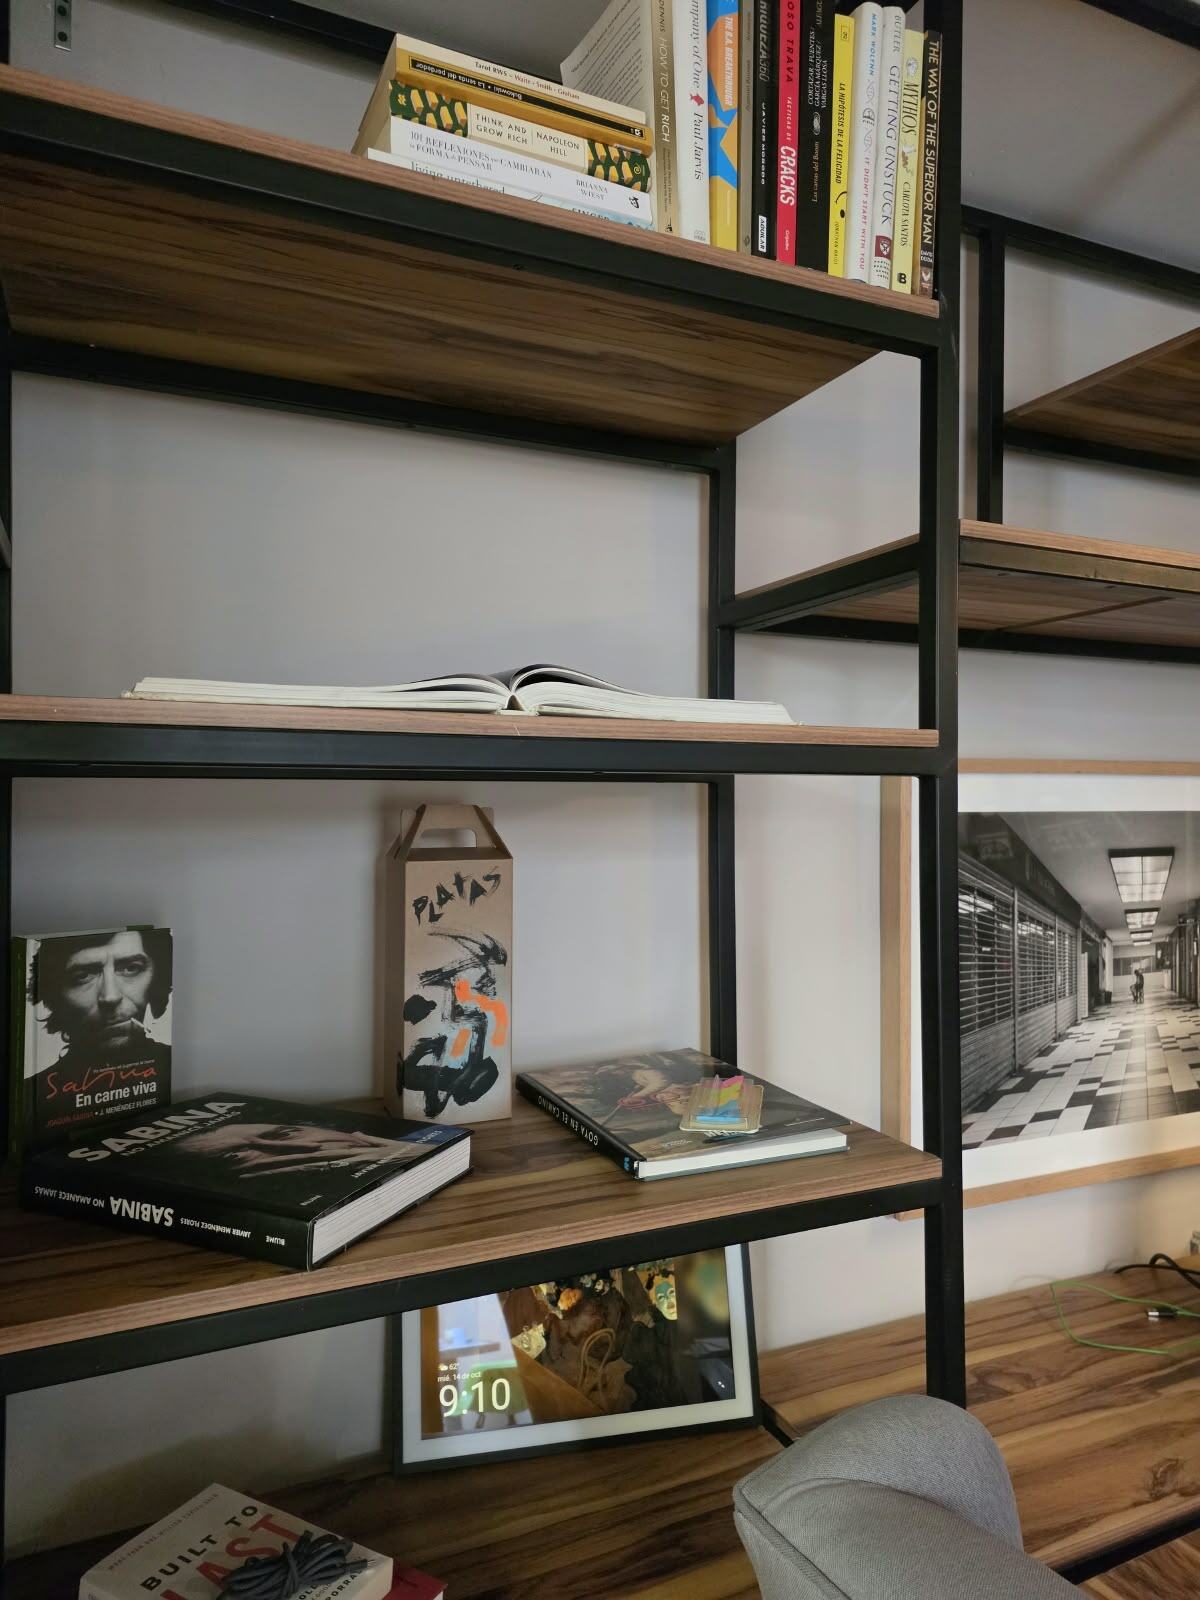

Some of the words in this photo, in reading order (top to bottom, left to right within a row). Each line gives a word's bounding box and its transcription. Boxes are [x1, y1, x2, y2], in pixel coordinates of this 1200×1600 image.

[659, 37, 668, 70] HOW
[786, 39, 794, 83] TRAVA
[928, 40, 939, 64] THE
[416, 62, 447, 77] perdedor
[447, 72, 457, 80] del
[660, 71, 669, 88] TO
[459, 76, 477, 85] senda
[839, 82, 846, 91] LA
[927, 68, 938, 98] WAY
[493, 86, 523, 101] Bukowski
[660, 90, 670, 112] GET
[886, 65, 901, 140] GETTING
[838, 92, 846, 127] HIPÓTESIS
[901, 80, 919, 135] MYTHOS
[927, 100, 937, 119] OF
[476, 113, 503, 127] THINK
[507, 124, 527, 134] AND
[661, 113, 670, 142] RICH
[693, 112, 704, 140] Paul
[837, 129, 844, 138] DE
[476, 125, 503, 137] GROW
[507, 133, 528, 144] RICH
[536, 131, 580, 150] NAPOLEON
[836, 139, 844, 147] LA
[926, 123, 936, 147] THE
[425, 137, 490, 161] REFLEXIONES
[550, 146, 568, 157] HILL
[458, 155, 493, 171] PENSAR
[693, 142, 704, 181] Jarvis
[835, 148, 843, 184] FELICIDAD
[576, 178, 608, 194] BRIANNA
[780, 145, 796, 206] CRACKS
[882, 145, 896, 225] UNSTUCK
[923, 148, 935, 210] SUPERIOR
[922, 214, 933, 245] MAN
[75, 1093, 91, 1108] En
[94, 1086, 130, 1104] carne
[132, 1081, 157, 1098] viva
[538, 1095, 560, 1117] CAMINO
[68, 1101, 248, 1162] SABINA
[569, 1118, 579, 1132] EN
[580, 1126, 599, 1146] GOYA
[34, 1186, 58, 1197] JAMÁS
[58, 1190, 92, 1204] AMANECE
[92, 1198, 105, 1208] NO
[110, 1196, 174, 1227] SABINA
[180, 1217, 200, 1228] FLORES
[201, 1221, 232, 1235] MENÉNDEZ
[232, 1227, 251, 1238] JAVIER
[266, 1235, 285, 1246] BLUME
[439, 1378, 511, 1417] 9:10
[140, 1534, 218, 1591] BUILT
[224, 1504, 258, 1535] TO
